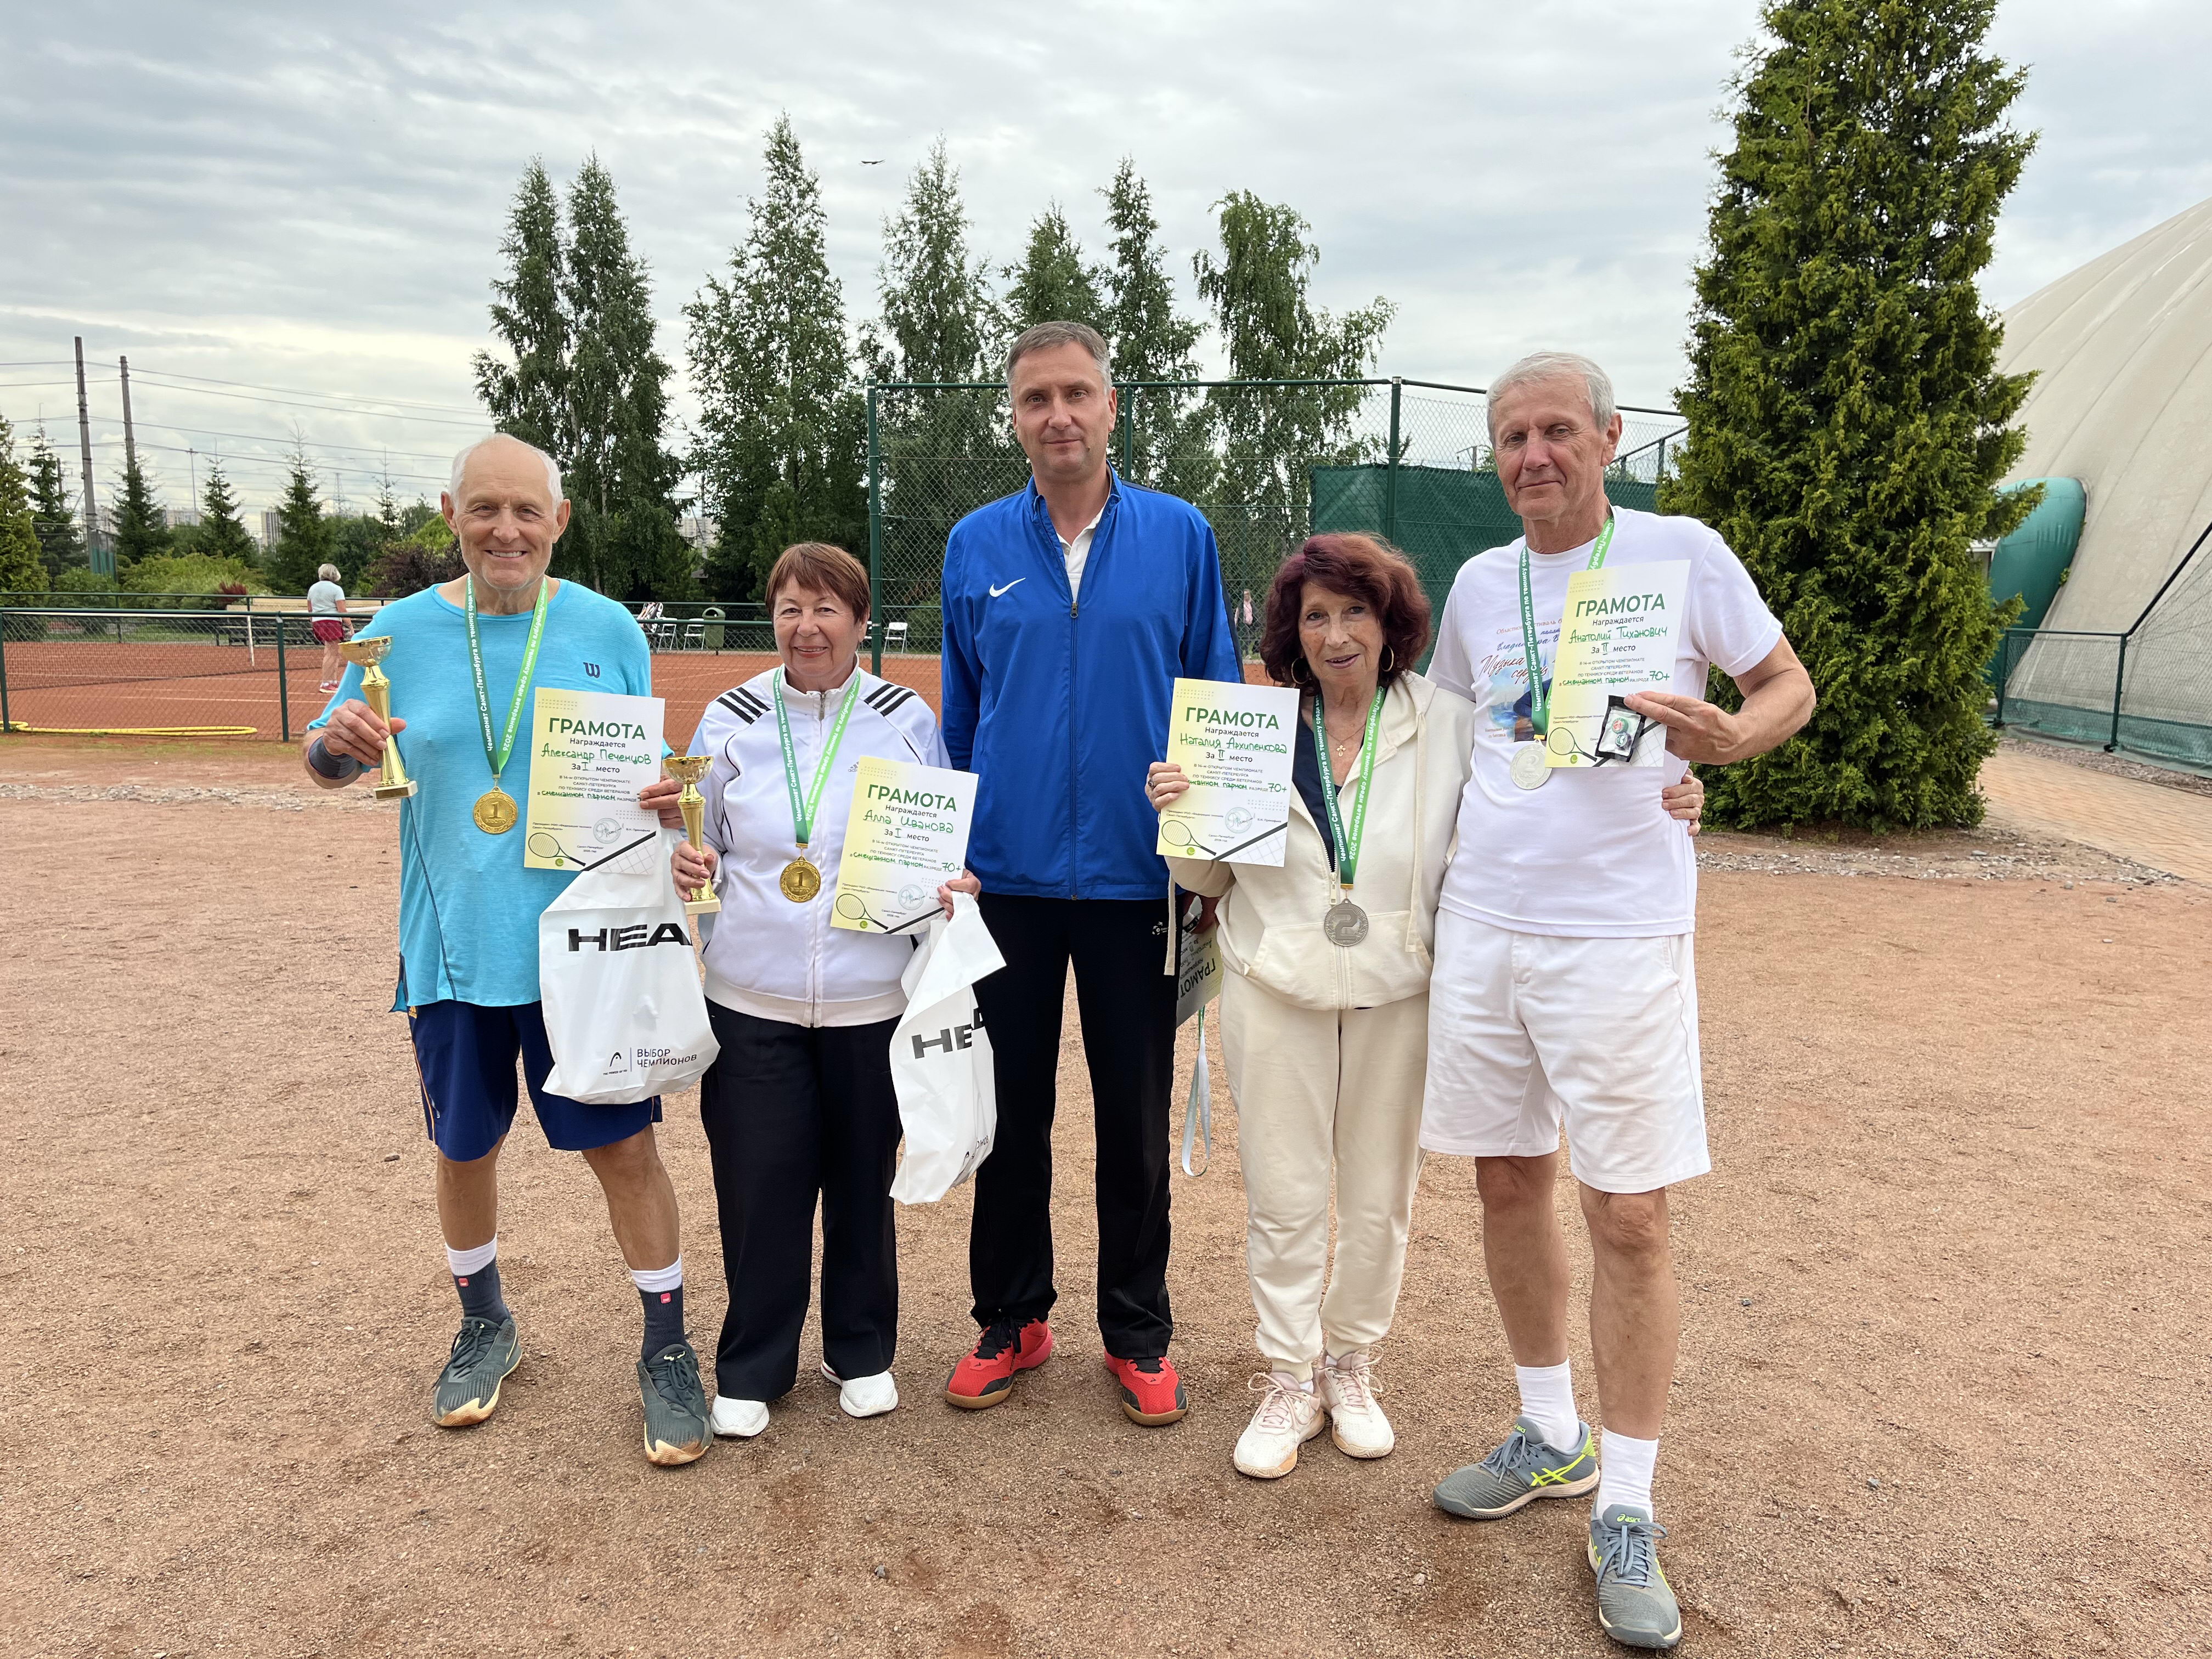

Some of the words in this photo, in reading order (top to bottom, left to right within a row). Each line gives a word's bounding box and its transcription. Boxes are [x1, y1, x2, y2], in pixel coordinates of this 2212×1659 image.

[1588, 522, 1613, 571] Санкт-Петербу
[1521, 568, 1529, 594] теннису
[1523, 595, 1530, 604] по
[1576, 593, 1666, 617] ГРАМОТА
[467, 612, 477, 637] теннису
[1592, 614, 1644, 627] Награждается
[471, 639, 477, 647] по
[528, 639, 537, 648] по
[1523, 605, 1537, 671] Санкт-Петербурга
[1567, 625, 1612, 644] Анатолий
[1613, 644, 1635, 652] место
[522, 648, 535, 675] теннису
[472, 648, 487, 712] Санкт-Петербурга
[516, 675, 528, 697] среди
[1649, 669, 1669, 682] 70+
[1531, 672, 1542, 711] Чемпионат
[506, 697, 521, 733] ветеранов
[1186, 707, 1280, 729] ГРАМОТА
[482, 712, 493, 751] Чемпионат
[549, 717, 647, 740] ГРАМОТА
[834, 724, 841, 732] по
[1205, 727, 1259, 738] Награждается
[502, 733, 512, 752] 2026
[569, 738, 625, 749] Награждается
[1179, 732, 1221, 749] Наталия
[1365, 742, 1372, 751] по
[540, 743, 595, 763] Александр
[599, 749, 652, 765] Печенцов
[783, 732, 797, 787] Санкт-Петербурга
[1321, 751, 1327, 759] по
[1361, 752, 1373, 781] теннису
[867, 783, 958, 812] ГРАМОТА
[1267, 782, 1286, 793] 70+
[1321, 761, 1338, 822] Санкт-Петербурга
[1357, 781, 1367, 803] среди
[792, 788, 803, 821] Чемпионат
[803, 804, 815, 821] 2026
[885, 804, 937, 819] Награждается
[863, 809, 893, 824] Алла
[900, 815, 954, 833] Иванова
[1351, 804, 1363, 841] ветеранов
[906, 833, 929, 842] место
[1334, 822, 1347, 861] Чемпионат
[1348, 842, 1357, 860] 2026
[940, 861, 962, 873] 70+
[1335, 910, 1359, 940] 2
[568, 923, 693, 951] HEA
[1180, 958, 1216, 998] ГРАМОТ
[911, 1007, 985, 1059] HEA
[637, 1048, 670, 1058] ВЫБОР
[637, 1054, 697, 1068] ЧЕМПИОНОВ
